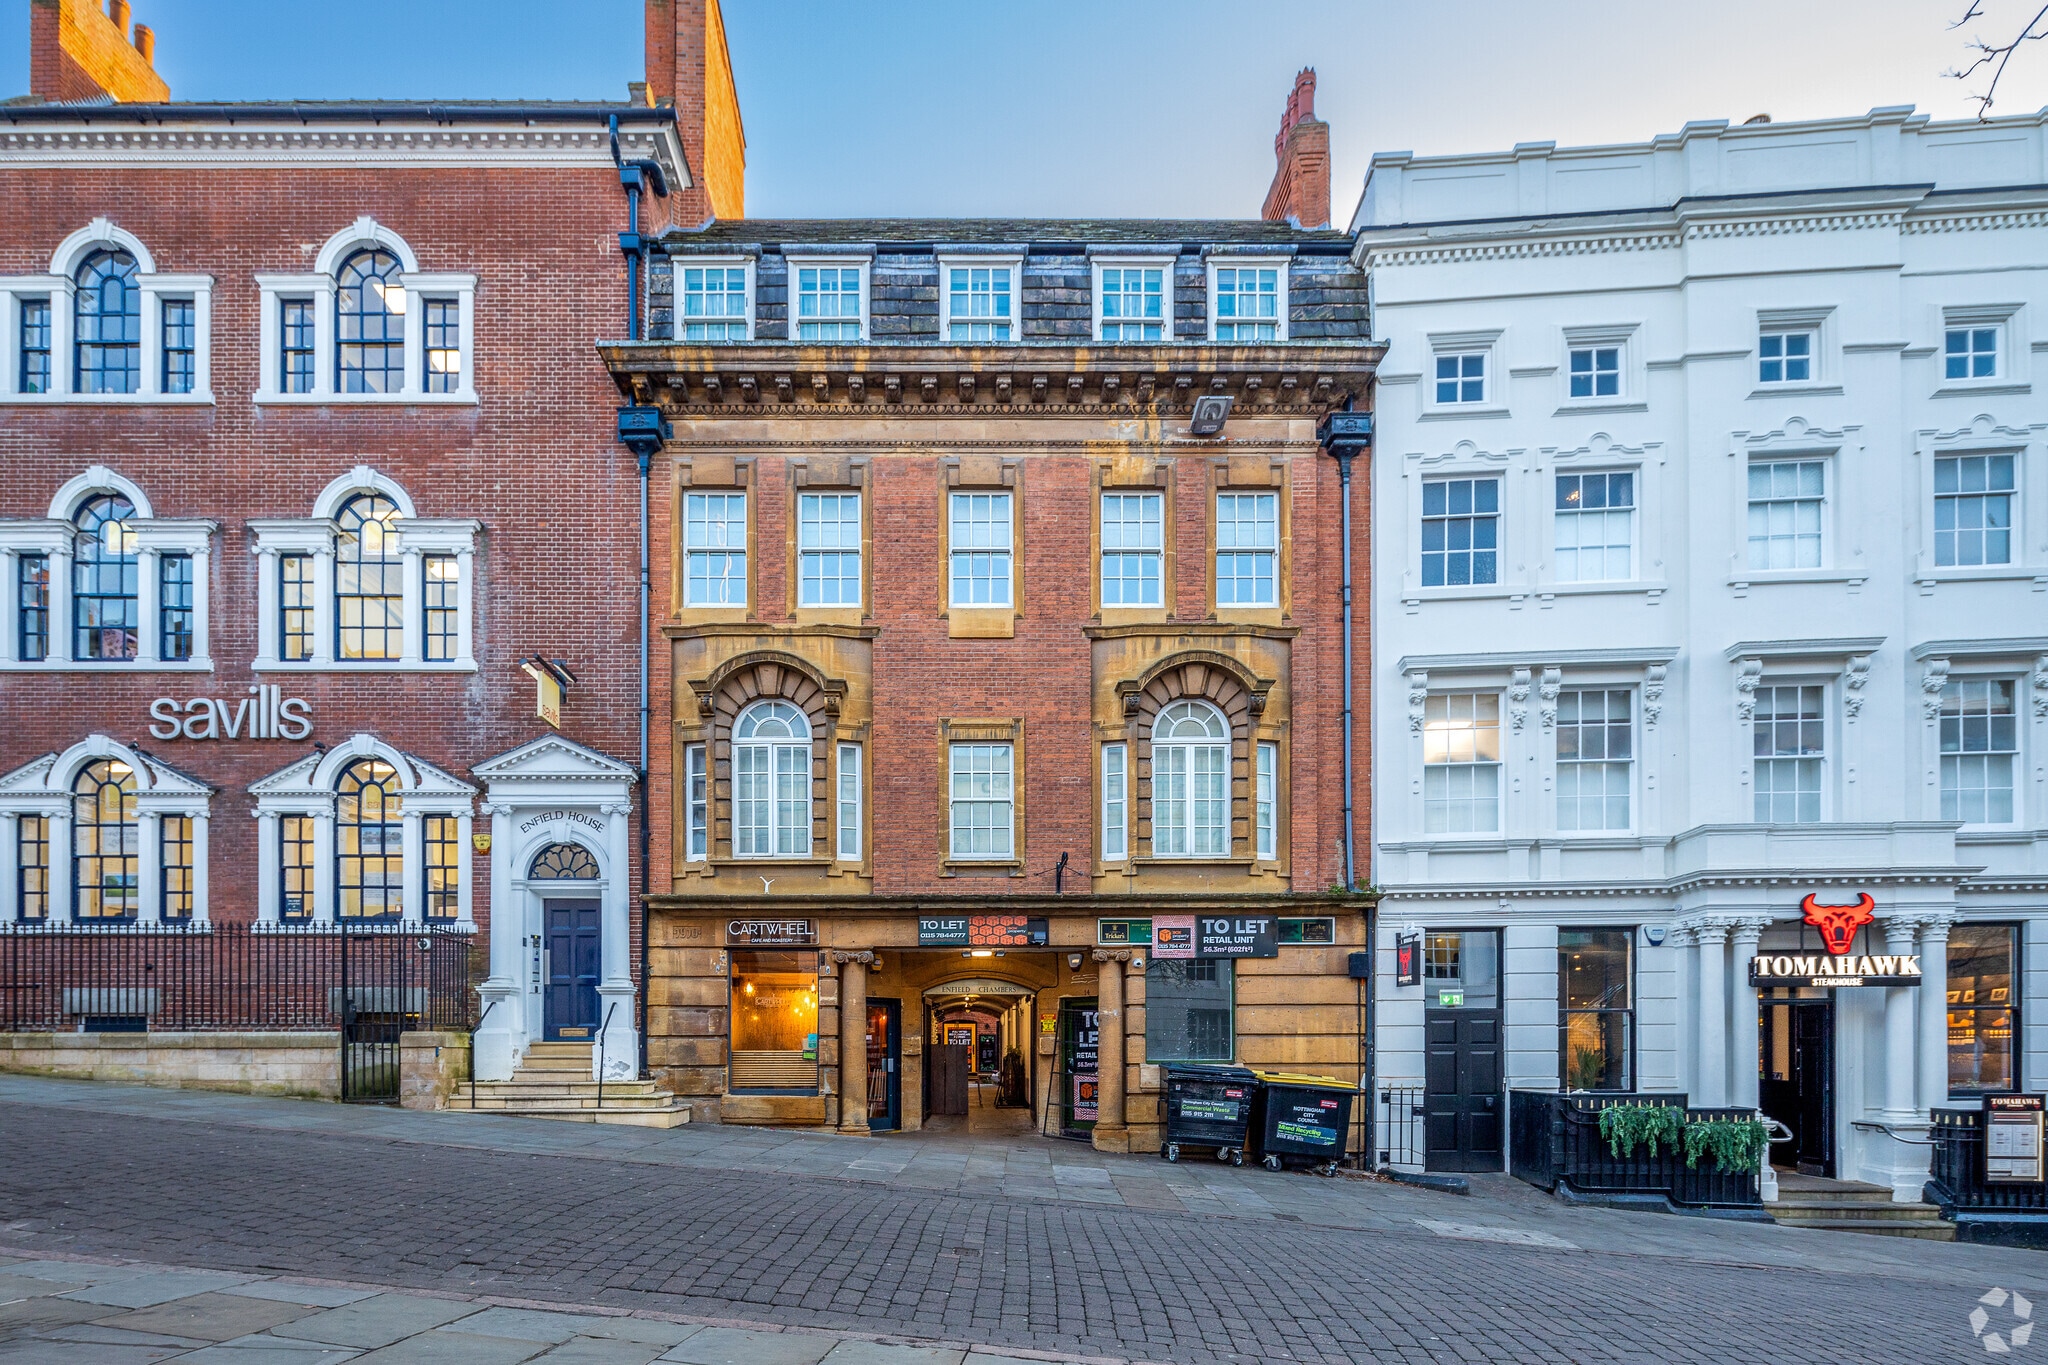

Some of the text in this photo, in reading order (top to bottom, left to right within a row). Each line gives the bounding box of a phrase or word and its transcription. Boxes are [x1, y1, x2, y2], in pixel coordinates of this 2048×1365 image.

[149, 684, 314, 740] savills
[542, 703, 559, 726] savills
[520, 810, 605, 834] ENFIELD HOUSE
[728, 920, 815, 936] CARTWHEEL
[920, 920, 966, 930] TO LET
[1202, 919, 1269, 934] TO LET
[1203, 936, 1255, 944] RETAIL UNIT
[1755, 955, 1922, 976] TOMAHAWK
[1811, 977, 1864, 987] STEAKHOUSE
[1079, 1030, 1099, 1048] LE
